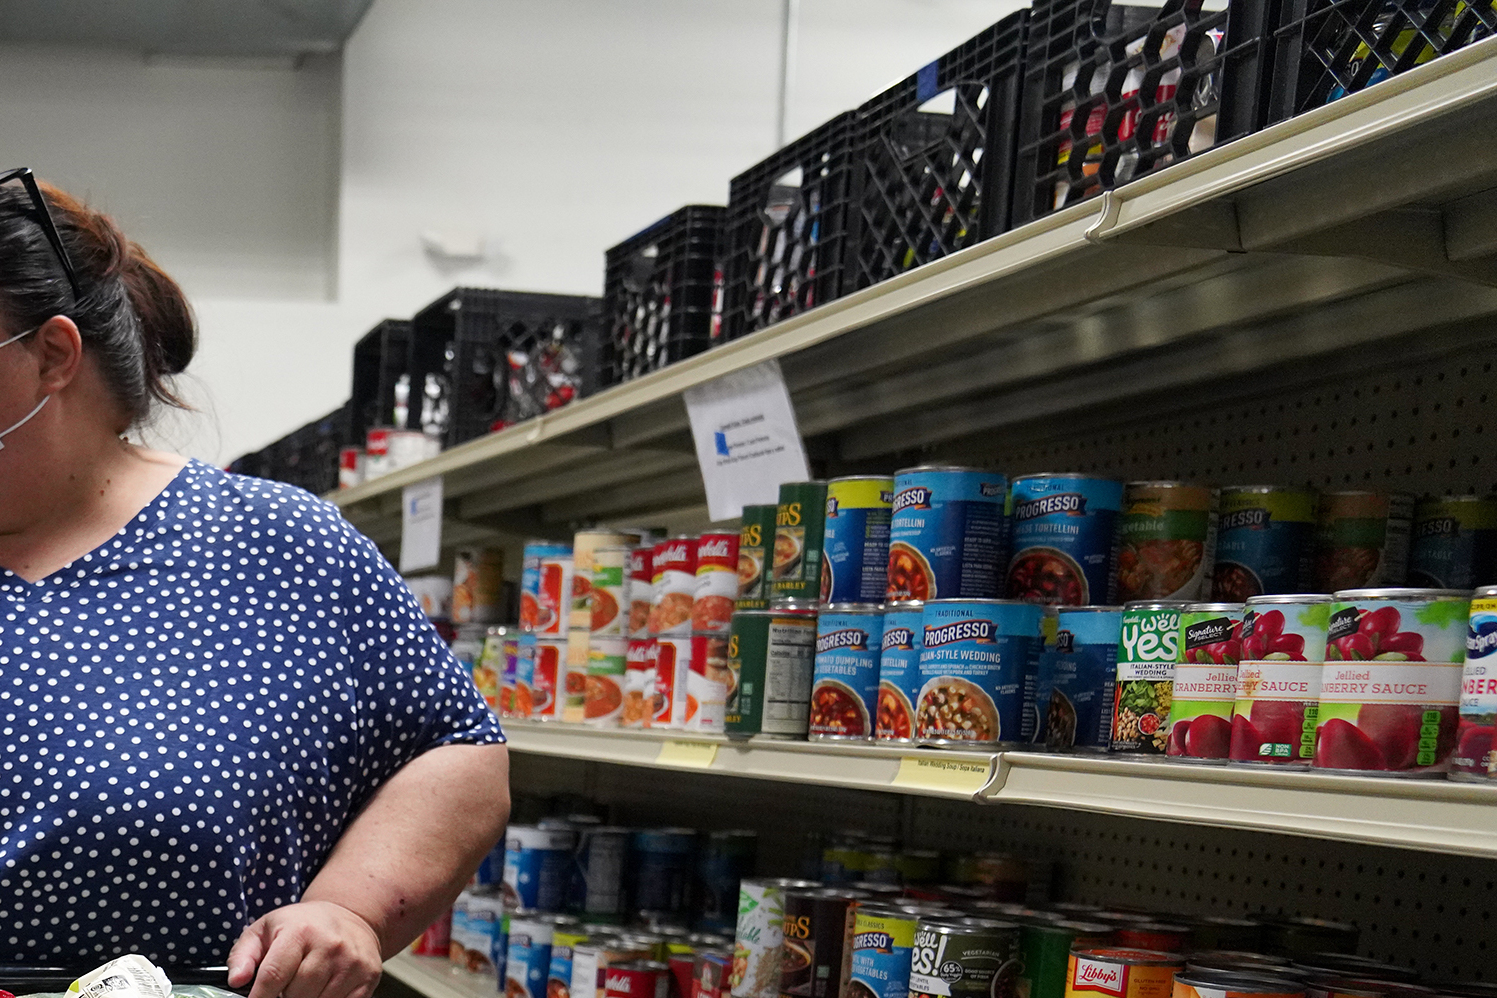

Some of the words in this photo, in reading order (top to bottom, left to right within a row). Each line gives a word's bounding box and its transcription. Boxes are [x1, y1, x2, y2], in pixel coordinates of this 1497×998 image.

[1015, 495, 1079, 520] PROGRESSO
[1034, 523, 1079, 534] TORTELLINI
[935, 609, 974, 618] TRADITIONAL
[925, 622, 989, 647] PROGRESSO
[1188, 624, 1224, 642] Signature
[1123, 625, 1179, 661] Yes
[961, 649, 1001, 664] WEDDING
[835, 657, 873, 669] DUMPLING
[1130, 663, 1175, 671] ITALIAN-STYLE
[1335, 670, 1370, 681] Jellied
[1175, 682, 1237, 693] CRANBERRY
[1261, 681, 1308, 692] SAUCE
[1371, 683, 1427, 695] SAUCE
[930, 761, 946, 770] Wedding
[946, 763, 957, 771] Soup
[1079, 963, 1118, 986] Libby's
